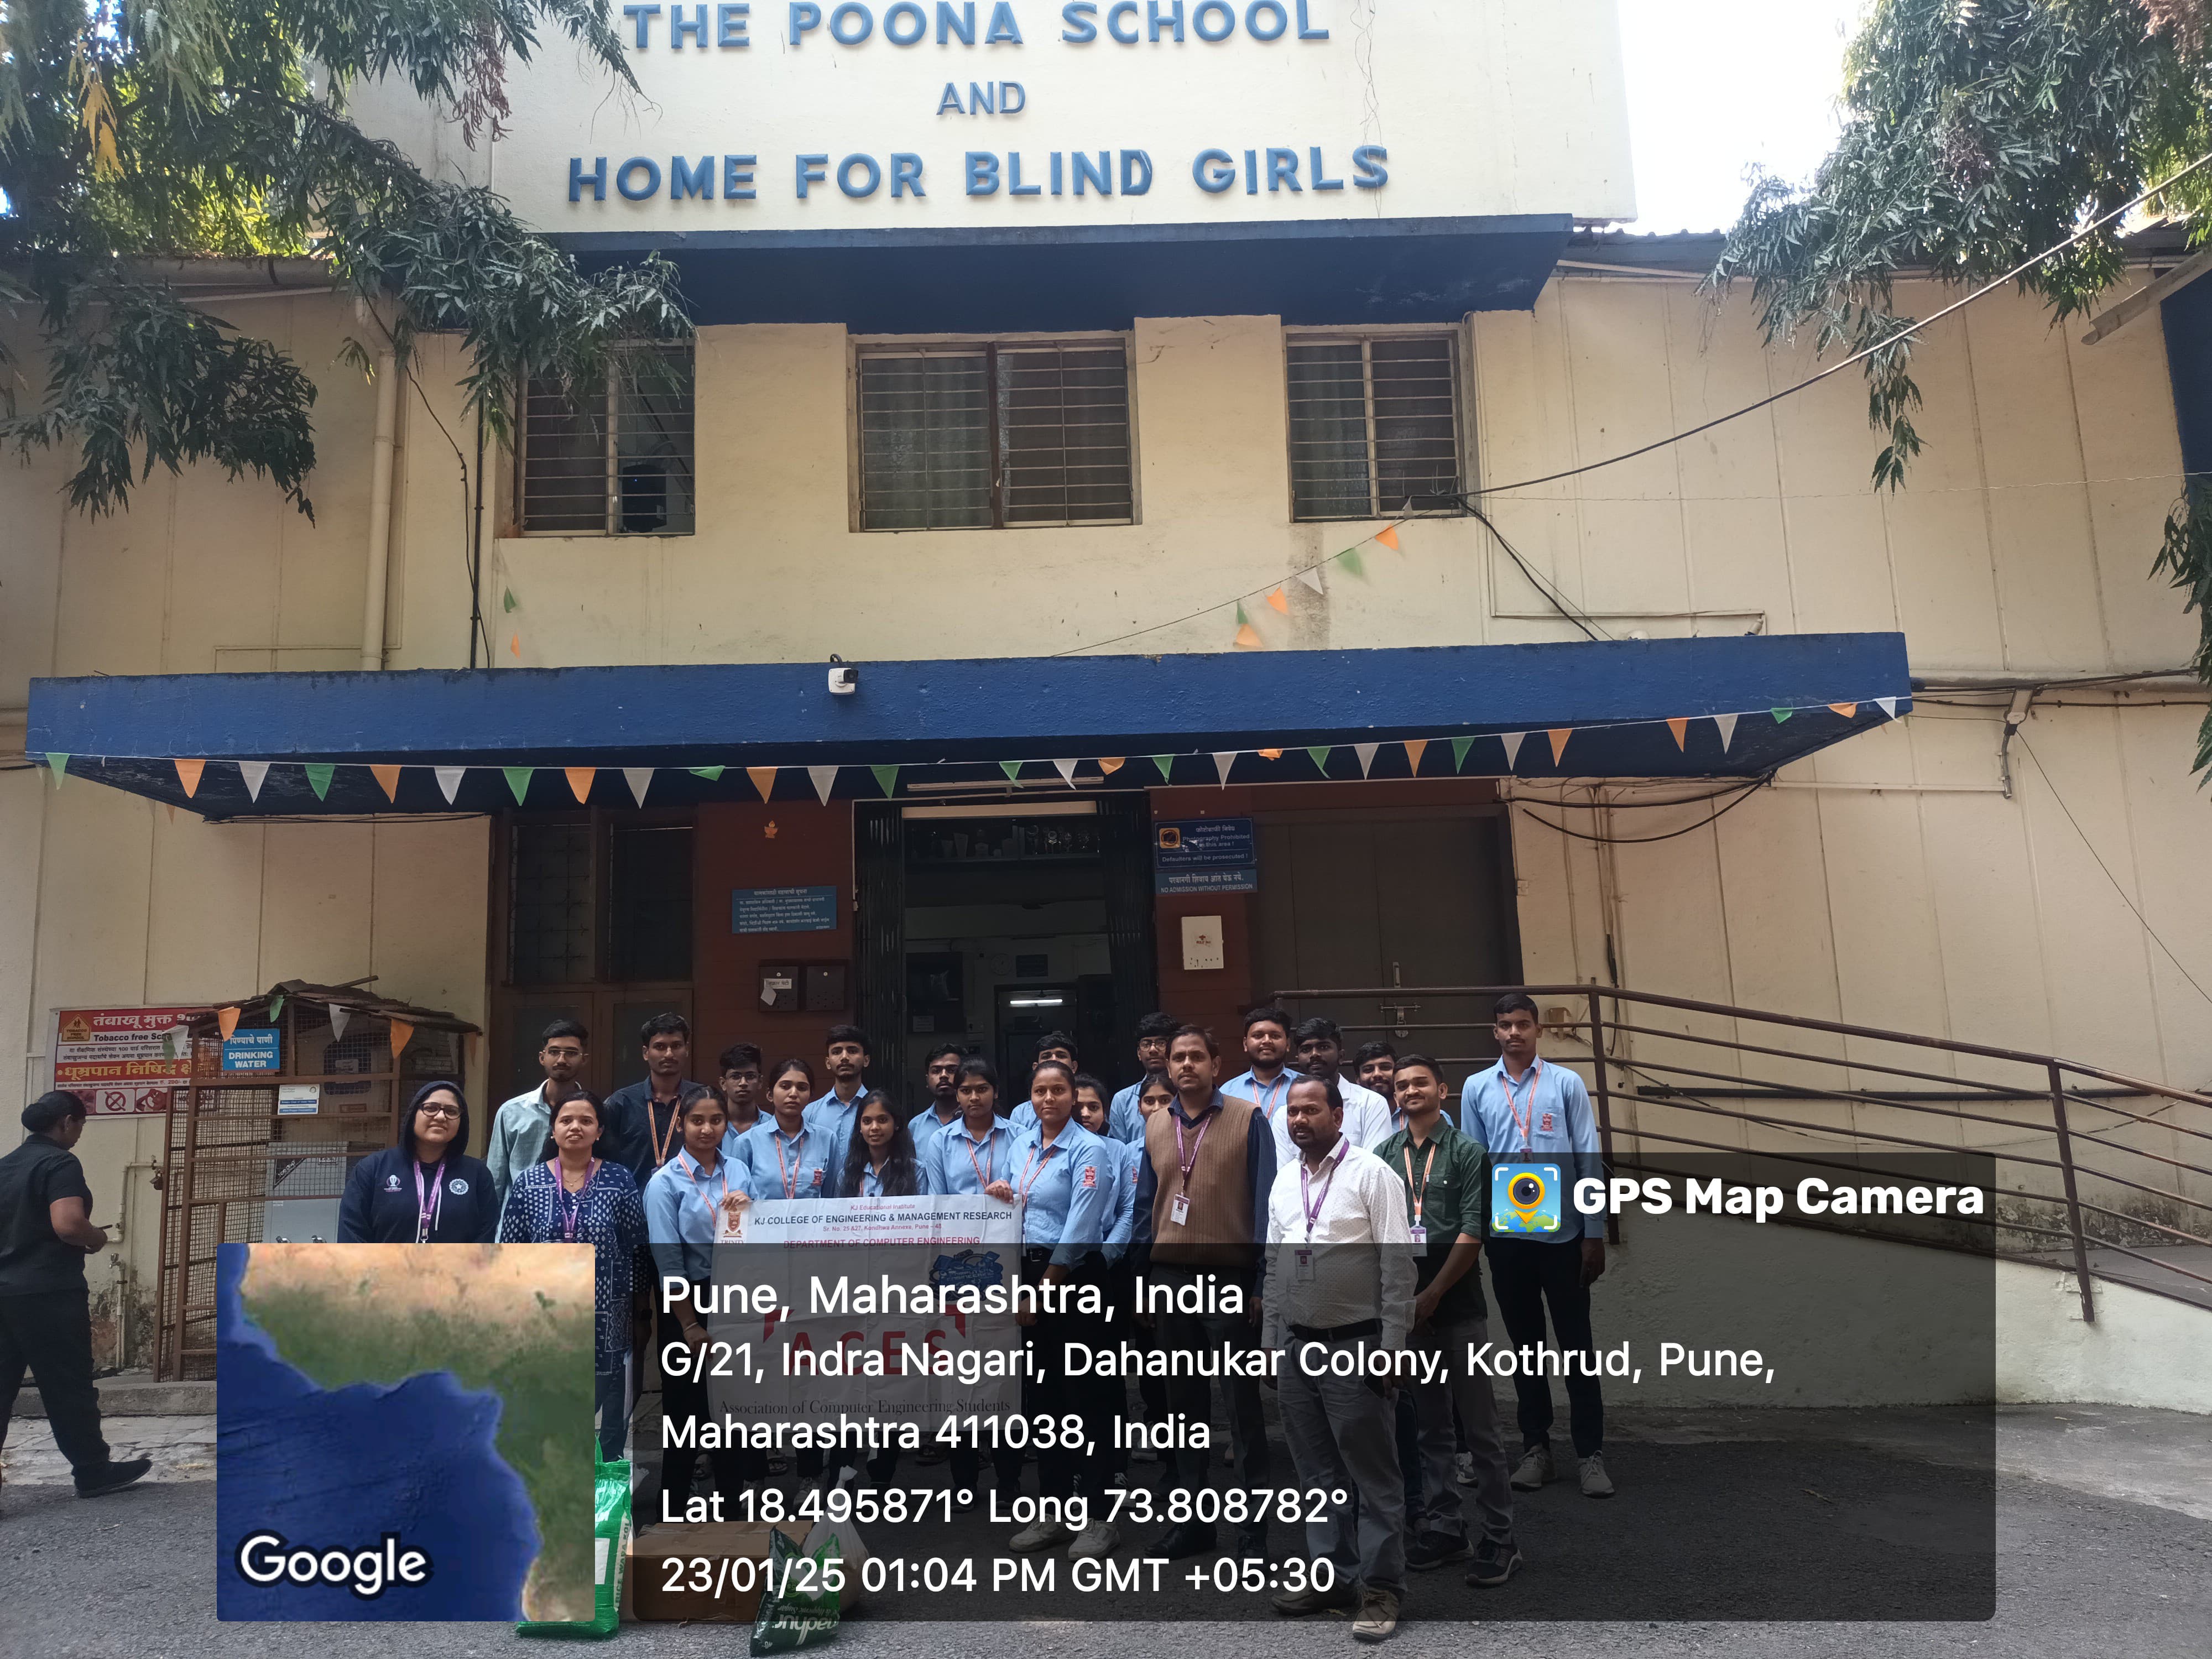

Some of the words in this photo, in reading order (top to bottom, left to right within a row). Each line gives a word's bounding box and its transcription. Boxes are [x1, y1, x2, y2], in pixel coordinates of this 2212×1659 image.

[623, 3, 750, 49] THE
[789, 1, 1023, 45] POONA
[1062, 0, 1330, 43] SCHOOL
[937, 81, 1026, 115] AND
[568, 154, 757, 202] HOME
[795, 153, 925, 199] FOR
[965, 149, 1153, 196] BLIND
[1192, 145, 1389, 195] GIRLS
[1168, 874, 1191, 884] परवानगी
[93, 1013, 141, 1029] तंबाखू
[143, 1014, 174, 1029] मुक्त
[229, 1034, 255, 1045] पिण्याचे
[257, 1033, 273, 1044] पाणी
[228, 1051, 273, 1060] DRINKING
[64, 1066, 122, 1081] धूम्रपान
[754, 1217, 765, 1225] KJ
[767, 1216, 809, 1225] COLLEGE
[811, 1215, 823, 1224] OF
[826, 1214, 886, 1223] ENGINEERING
[889, 1213, 895, 1222] &
[898, 1212, 961, 1222] MANAGEMENT
[963, 1212, 1012, 1220] RESEARCH
[784, 1239, 846, 1249] DEPARTMENT
[848, 1239, 860, 1248] OF
[863, 1237, 914, 1248] COMPUTER
[917, 1237, 980, 1245] ENGINEERING
[789, 1330, 948, 1376] ACES
[719, 1400, 789, 1413] Association
[792, 1400, 807, 1415] of
[810, 1400, 874, 1416] Computer
[878, 1399, 953, 1417] Engineering
[956, 1398, 1011, 1413] Students
[615, 1578, 623, 1603] RICE
